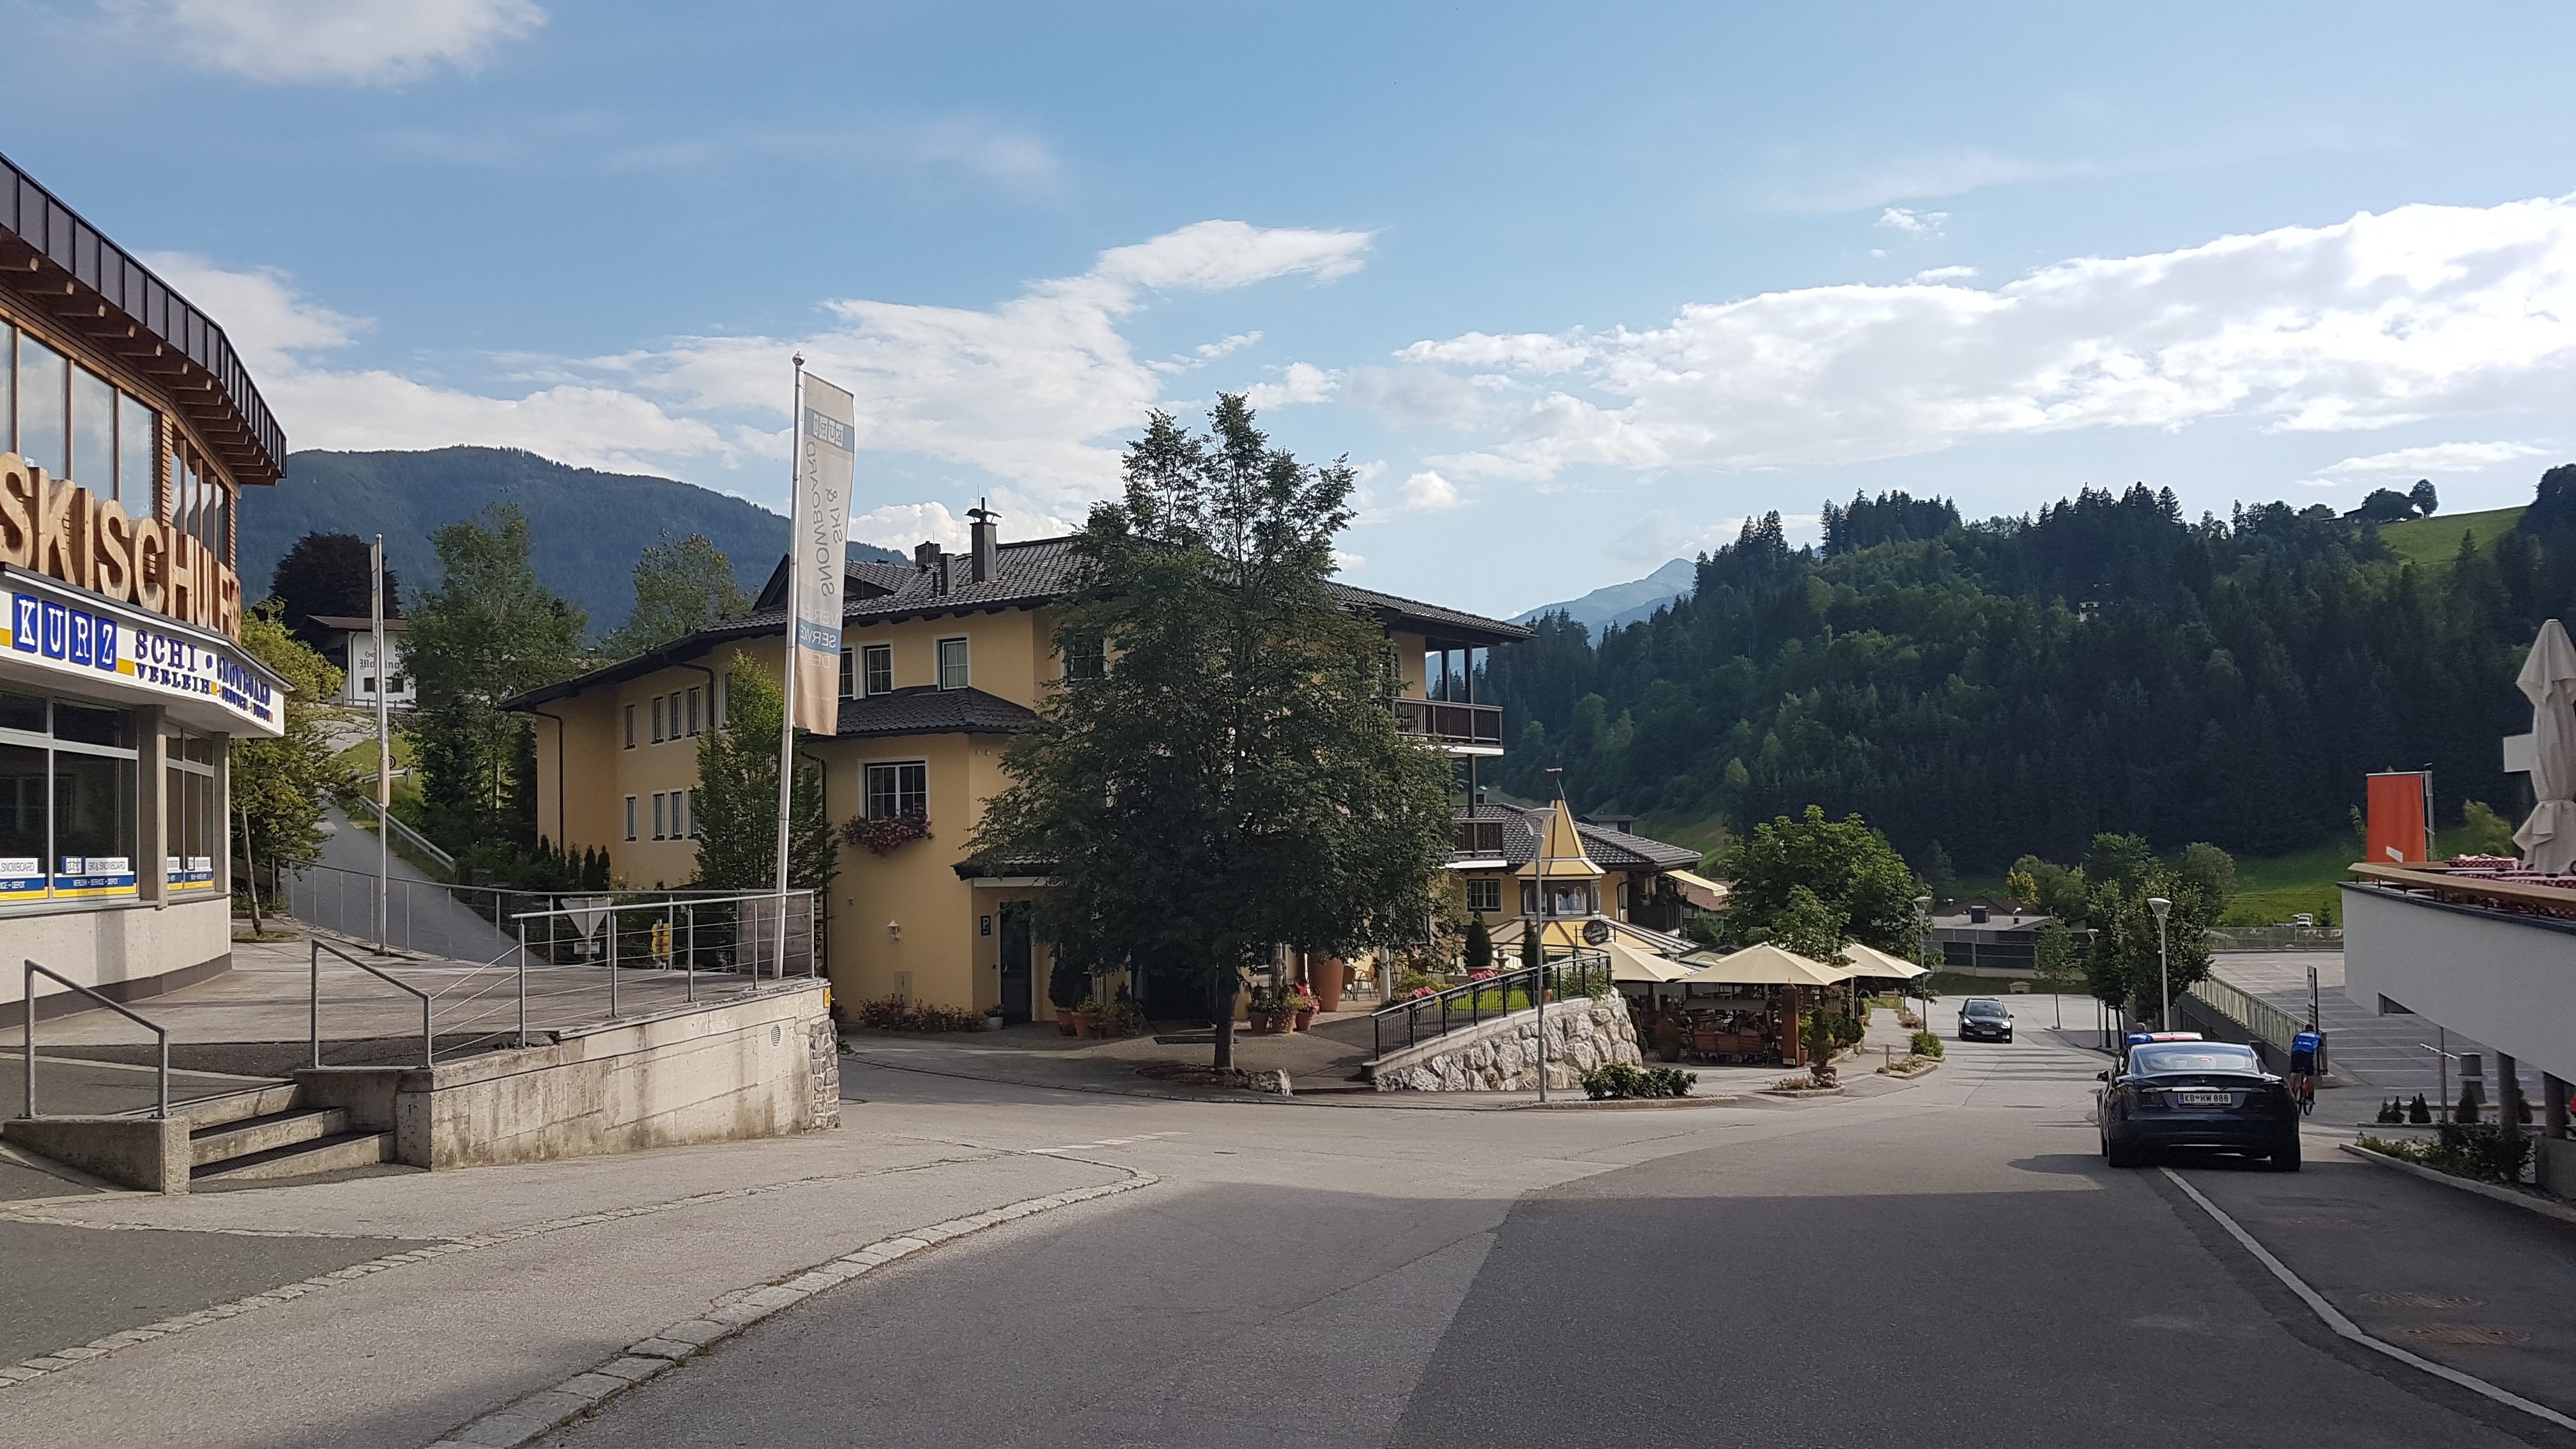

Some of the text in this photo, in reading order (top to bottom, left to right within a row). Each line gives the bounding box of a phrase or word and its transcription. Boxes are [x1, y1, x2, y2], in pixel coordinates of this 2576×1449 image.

[18, 599, 114, 666] KURZ
[135, 629, 272, 707] SCHI SNOWBOARD
[135, 663, 211, 695] VERLEIH
[359, 659, 400, 670] Maina
[983, 917, 989, 929] P
